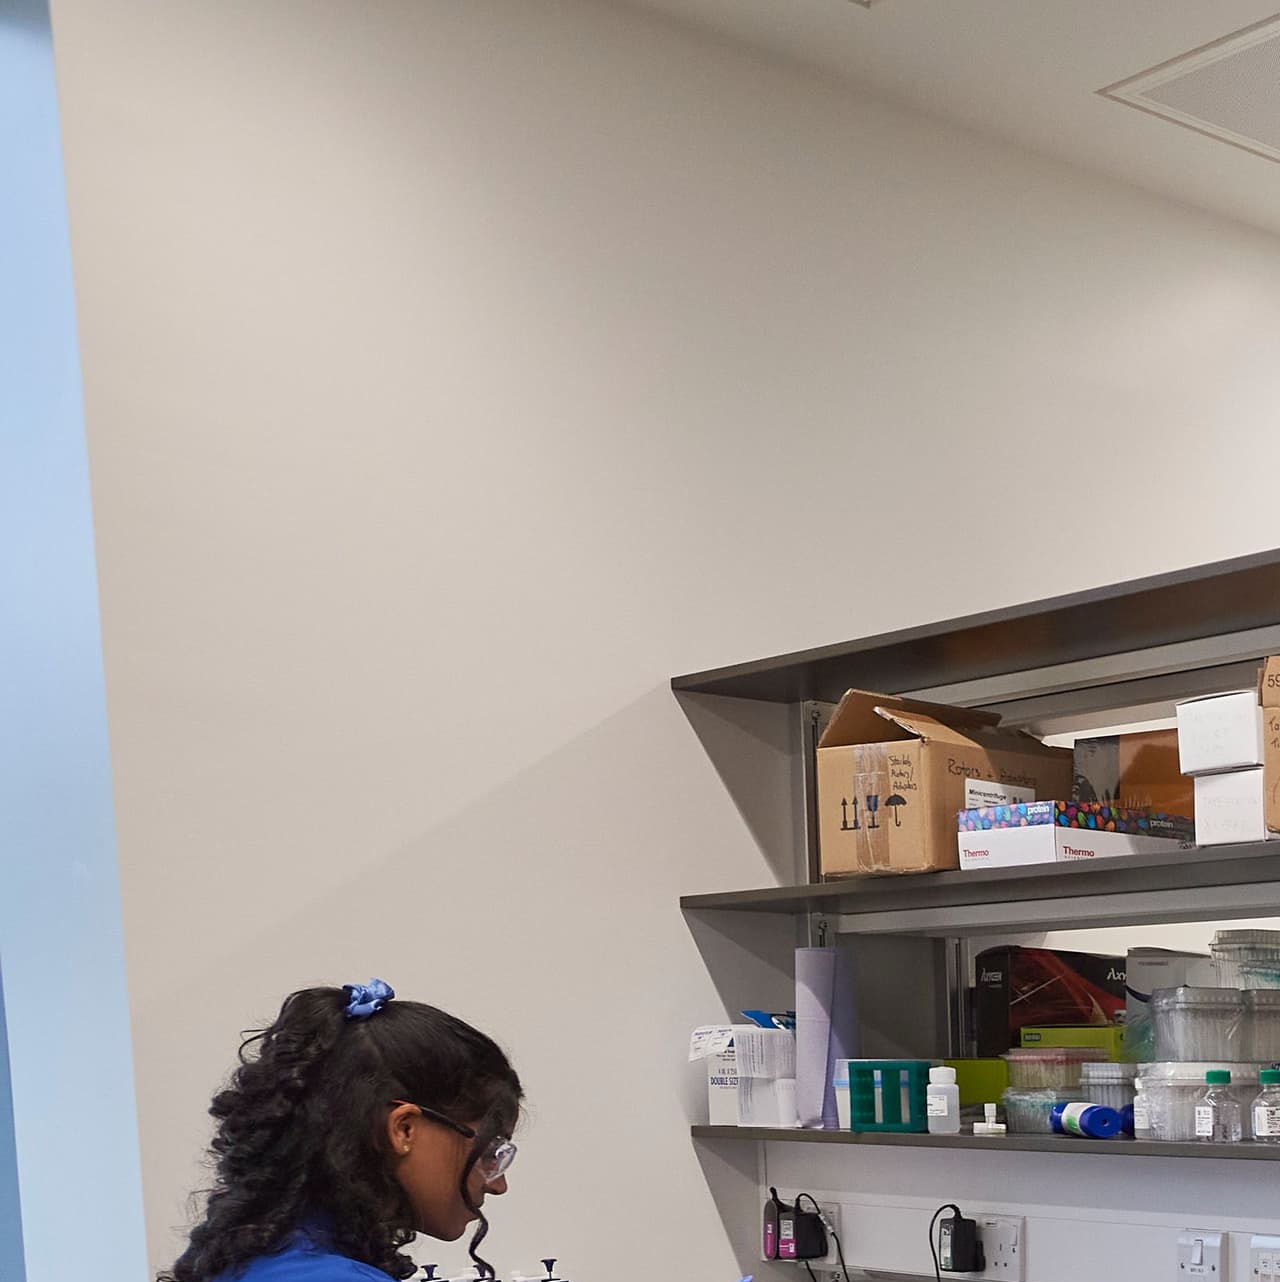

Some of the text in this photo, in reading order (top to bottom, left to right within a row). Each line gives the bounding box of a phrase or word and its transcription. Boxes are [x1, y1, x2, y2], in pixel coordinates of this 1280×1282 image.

[1027, 804, 1050, 814] protein
[1150, 820, 1174, 829] protein
[963, 849, 989, 857] Thermo
[1063, 846, 1095, 857] Thermo
